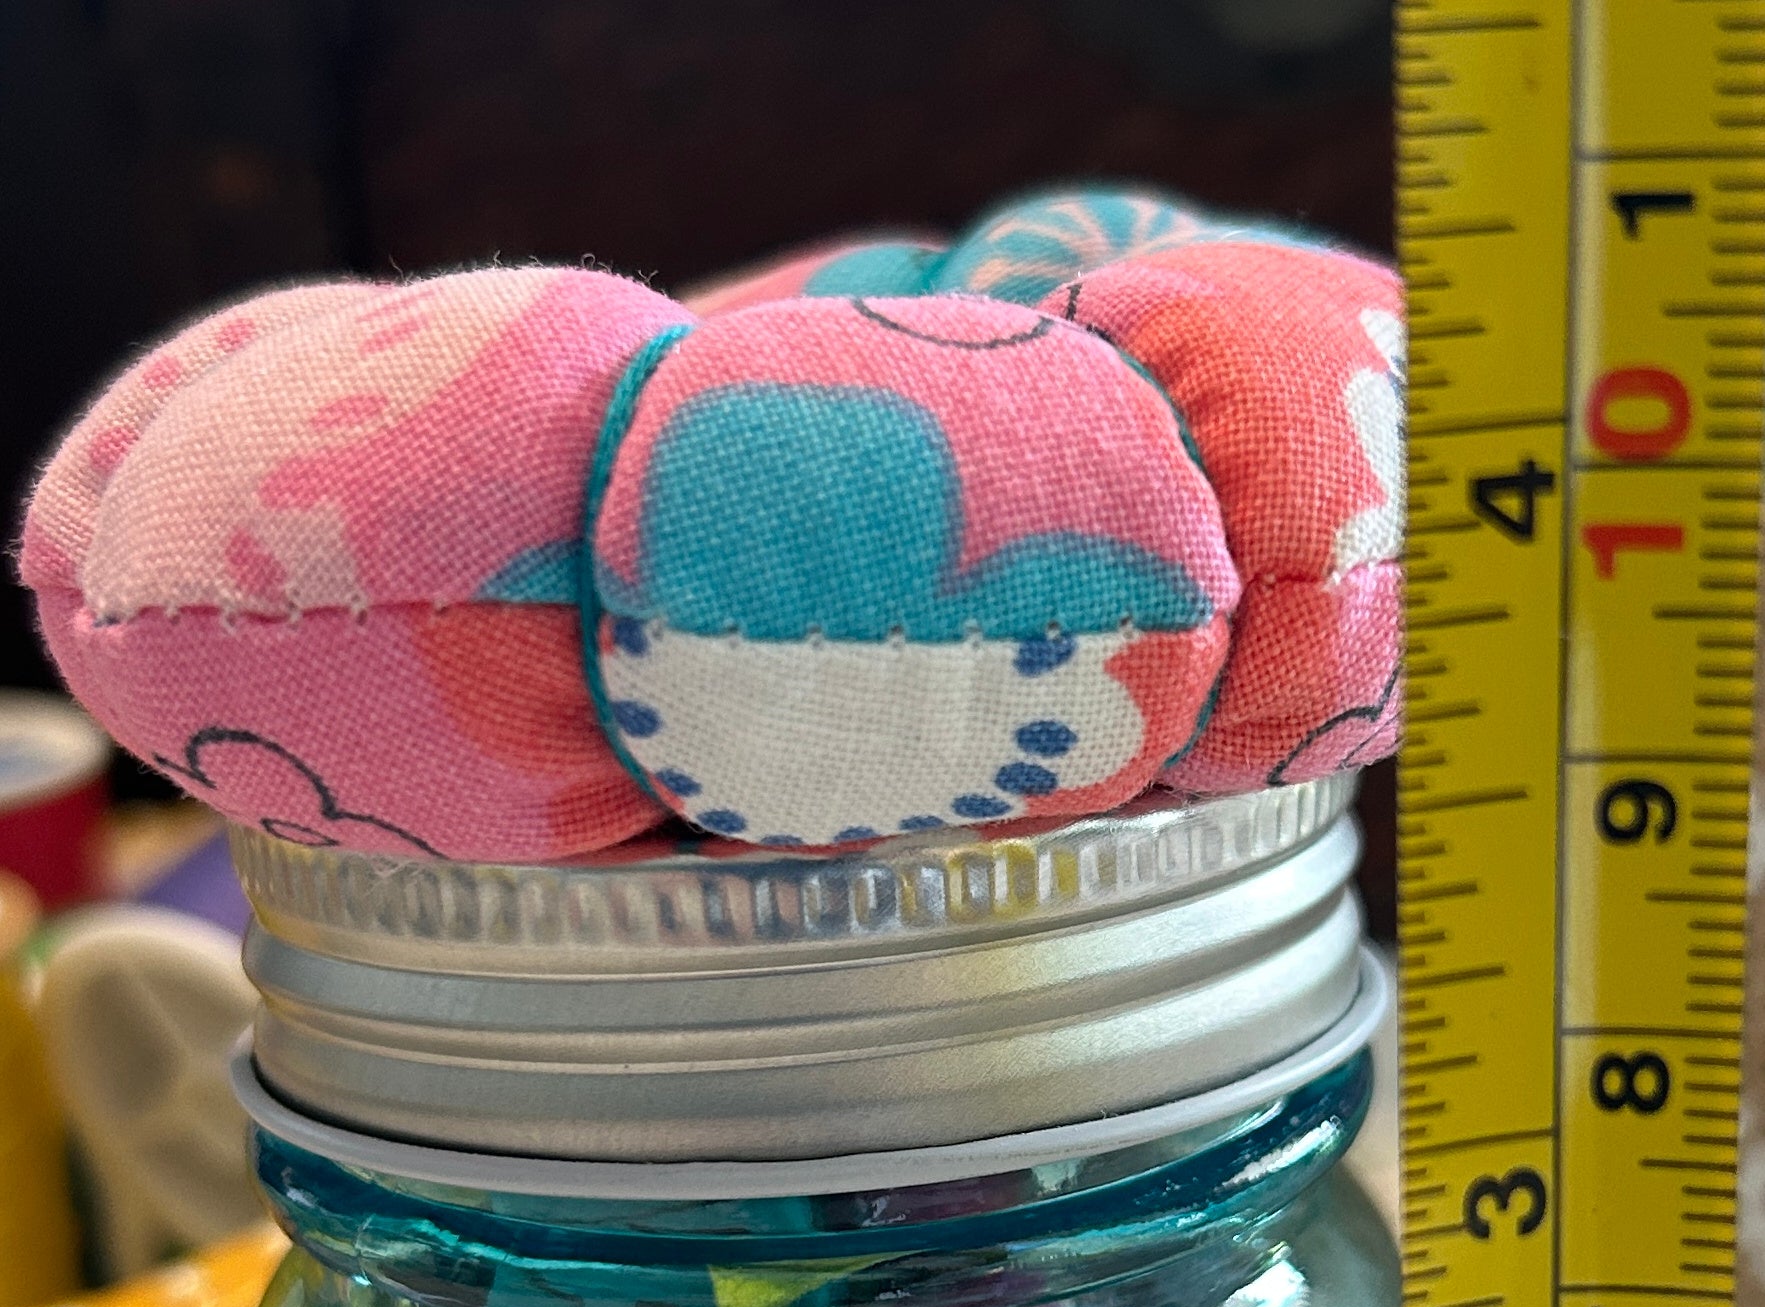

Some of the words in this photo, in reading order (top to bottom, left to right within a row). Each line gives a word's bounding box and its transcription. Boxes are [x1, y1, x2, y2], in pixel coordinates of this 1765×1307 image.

[1609, 189, 1697, 240] 1
[1467, 458, 1557, 544] 4
[1595, 777, 1681, 848] 9
[1590, 1050, 1672, 1117] 8
[1459, 1166, 1549, 1240] 3
